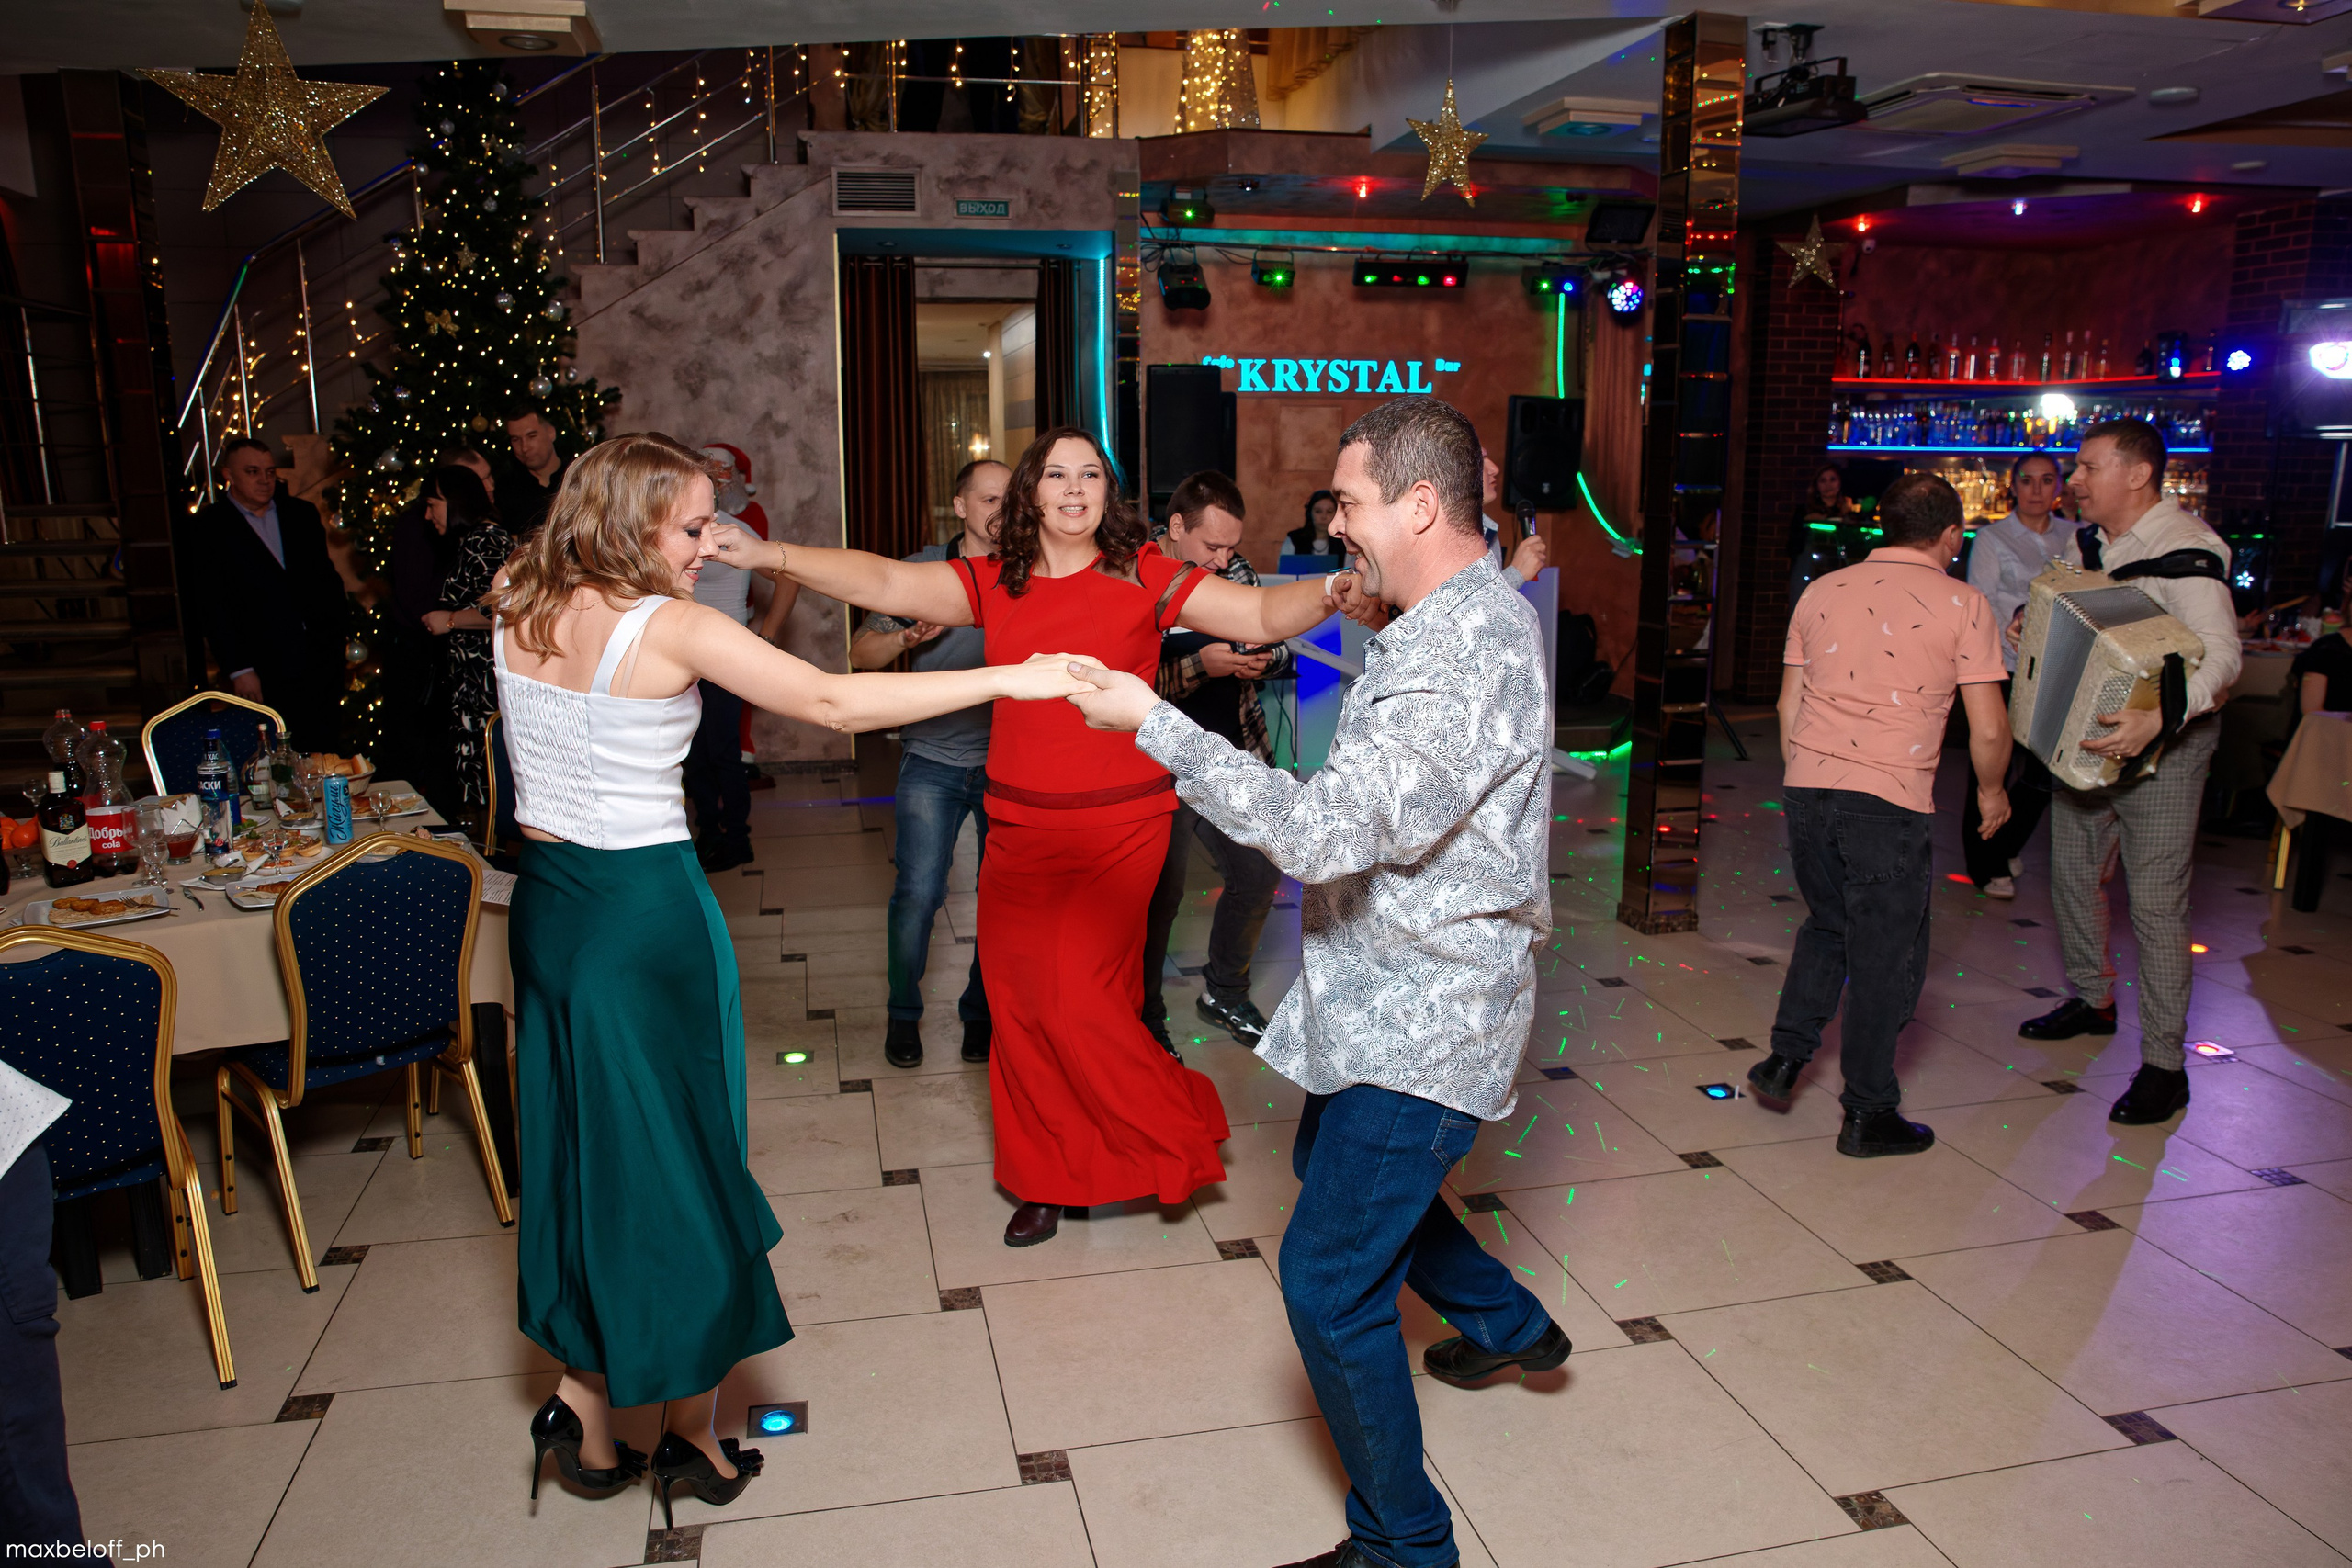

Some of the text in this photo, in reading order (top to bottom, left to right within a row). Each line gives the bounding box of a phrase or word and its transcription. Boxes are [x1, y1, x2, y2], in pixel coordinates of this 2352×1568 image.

[959, 202, 1006, 215] ВЫХОД
[1237, 358, 1432, 394] KRYSTAL
[1435, 358, 1461, 372] Bar
[198, 780, 221, 791] АСКИ
[328, 784, 348, 840] Жигули
[101, 840, 121, 849] cola
